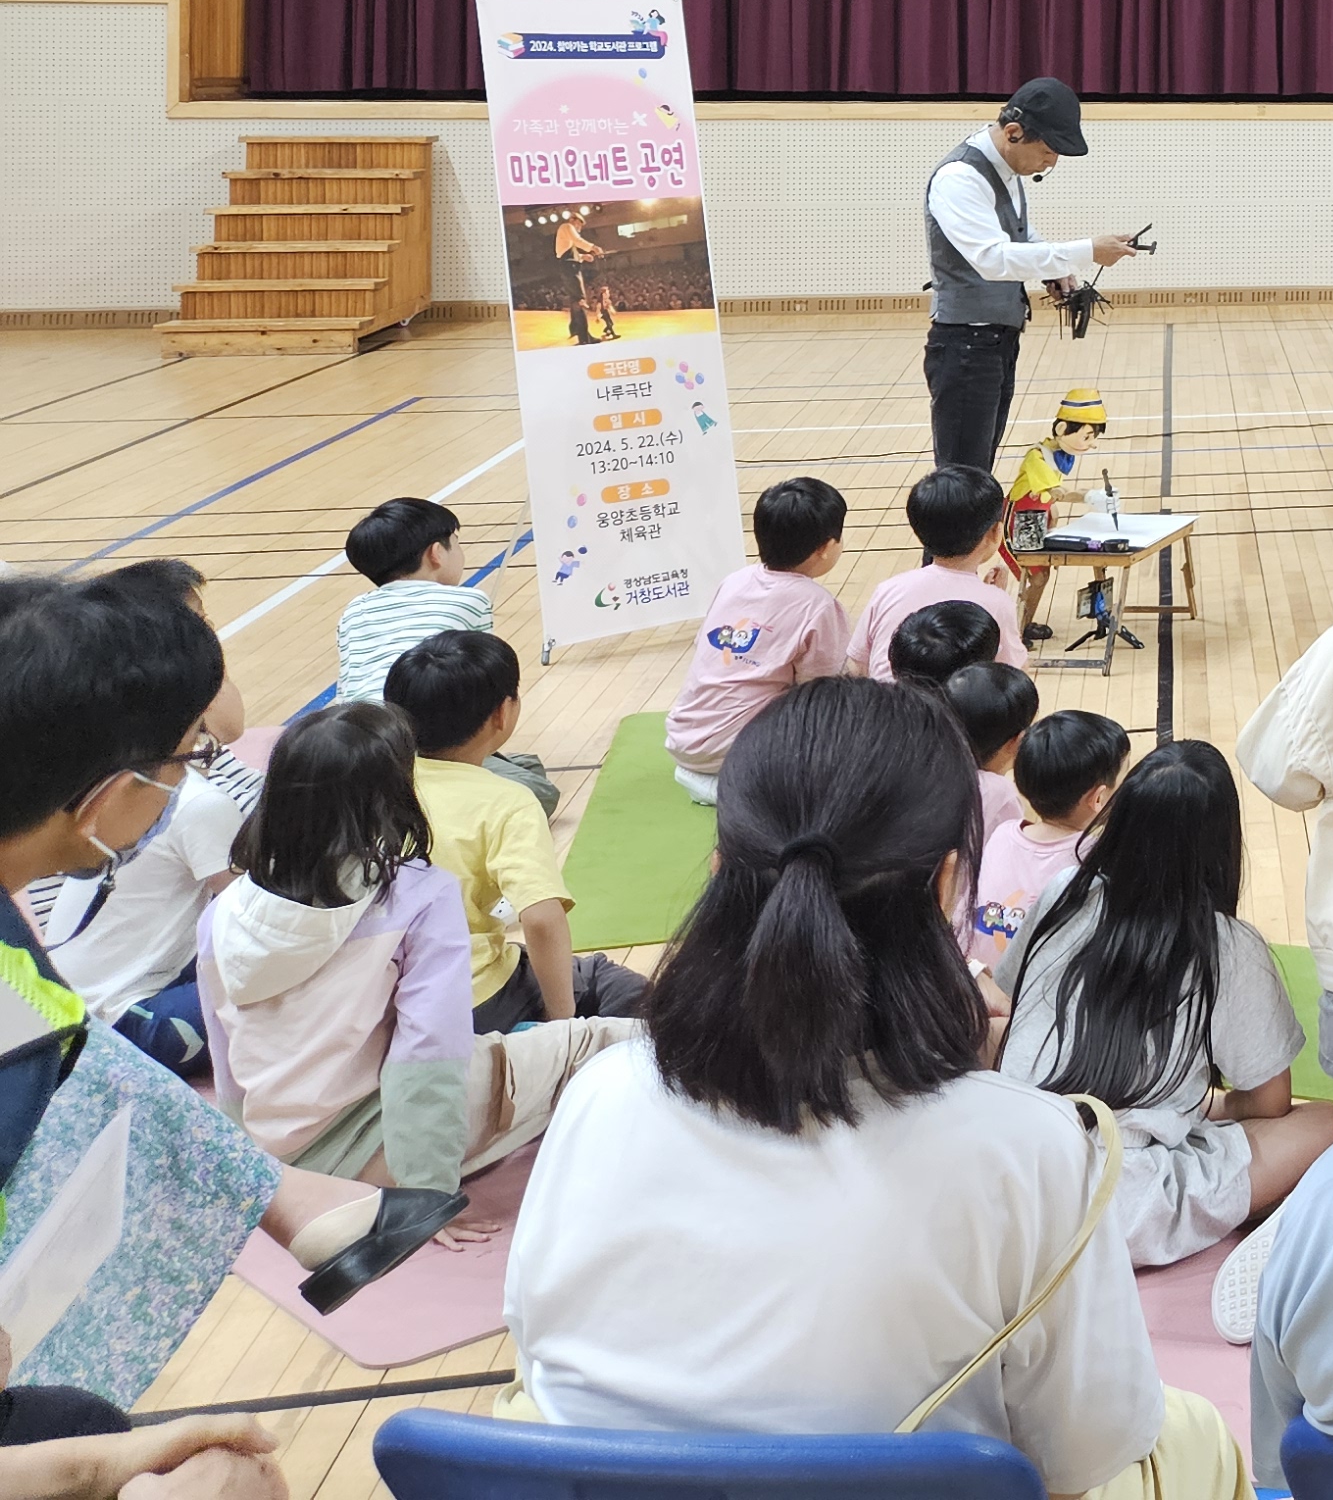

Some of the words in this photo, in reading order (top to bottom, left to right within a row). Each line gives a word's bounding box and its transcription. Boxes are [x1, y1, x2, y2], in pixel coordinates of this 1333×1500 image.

[529, 39, 556, 53] 2024.
[557, 40, 589, 53] 찾아가는
[589, 40, 627, 53] 학교도서관
[627, 40, 659, 54] 프로그램
[513, 118, 560, 137] 가족과
[565, 118, 630, 137] 함께하는
[510, 145, 634, 189] 마리오네트
[639, 141, 686, 188] 공연
[603, 359, 641, 376] 극단명
[596, 381, 653, 402] 나루극단
[576, 440, 617, 458] 2024.
[621, 437, 634, 451] 5.
[637, 430, 684, 450] 22.(수)
[591, 451, 675, 475] 13:20~14:10
[596, 502, 681, 529] 웅양초등학교
[619, 524, 662, 544] 체육관
[623, 568, 689, 589] 경상남도교육청
[626, 583, 690, 606] 거창도서관
